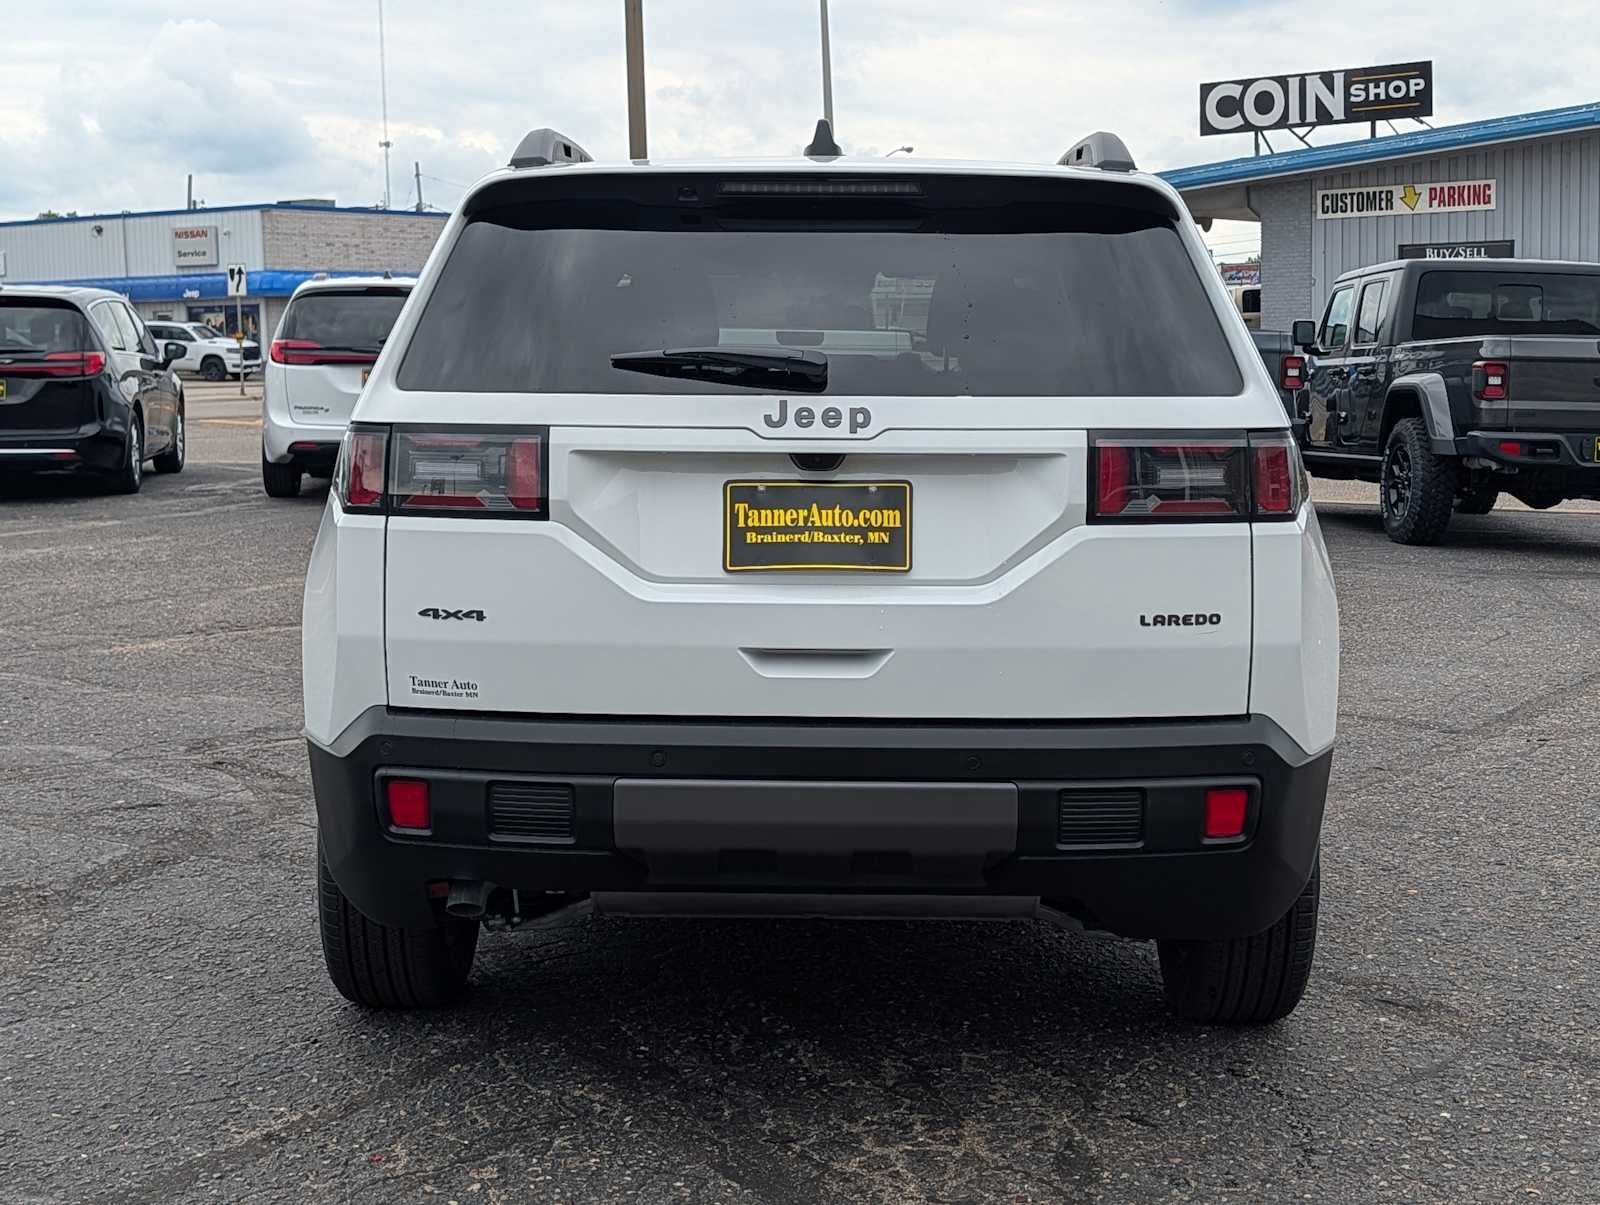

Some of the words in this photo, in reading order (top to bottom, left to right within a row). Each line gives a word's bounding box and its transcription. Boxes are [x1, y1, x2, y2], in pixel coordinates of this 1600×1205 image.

[1205, 73, 1346, 130] COIN
[1350, 78, 1426, 103] SHOP
[1321, 189, 1394, 214] CUSTOMER
[1428, 184, 1492, 208] PARKING
[175, 229, 207, 239] NISSAN
[177, 250, 207, 258] Service
[764, 400, 872, 433] Jeep
[735, 502, 901, 528] TannerAuto.com
[746, 531, 864, 545] Brainerd/Baxter,
[868, 531, 890, 544] MN
[1140, 613, 1221, 627] LAREDO
[409, 675, 448, 689] Tanner
[451, 680, 478, 690] Auto
